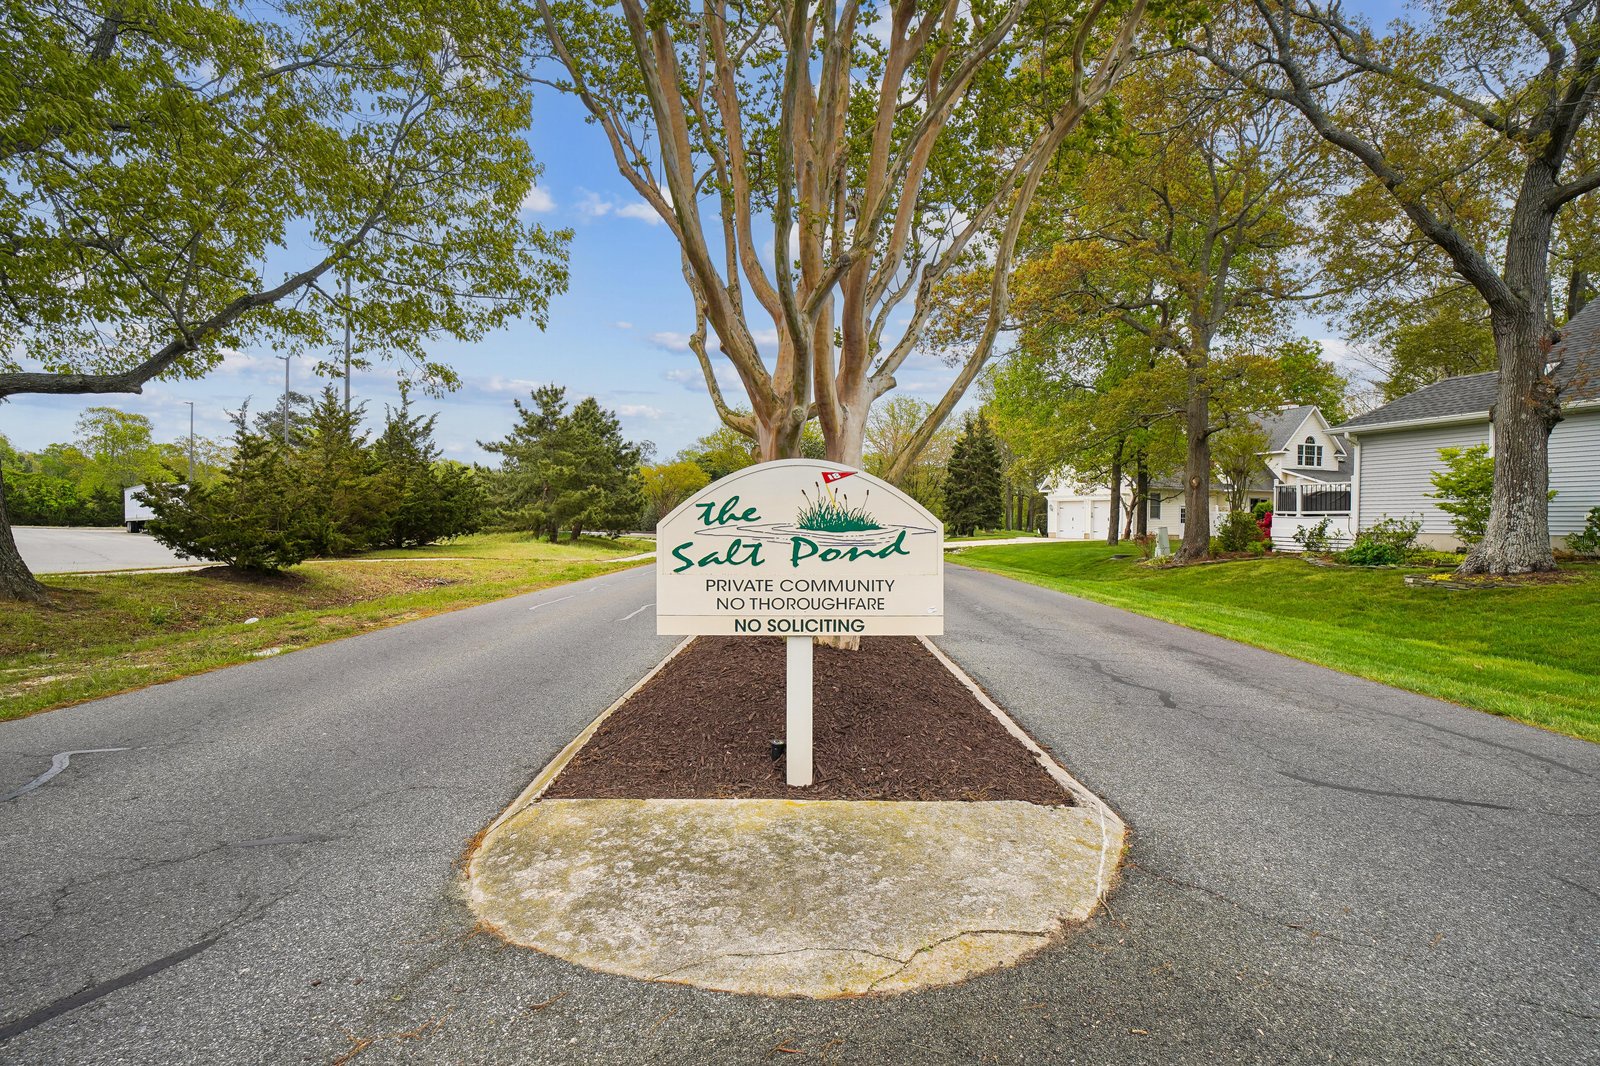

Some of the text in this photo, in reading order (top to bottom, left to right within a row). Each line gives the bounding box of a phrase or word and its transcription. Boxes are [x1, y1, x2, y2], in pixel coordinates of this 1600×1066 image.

[827, 472, 841, 480] 18
[696, 495, 762, 526] the
[672, 530, 910, 573] Salt Pond
[705, 579, 895, 592] PRIVATE COMMUNITY
[716, 597, 885, 611] NO THOROUGHFARE
[734, 618, 865, 633] NO SOLICITING
